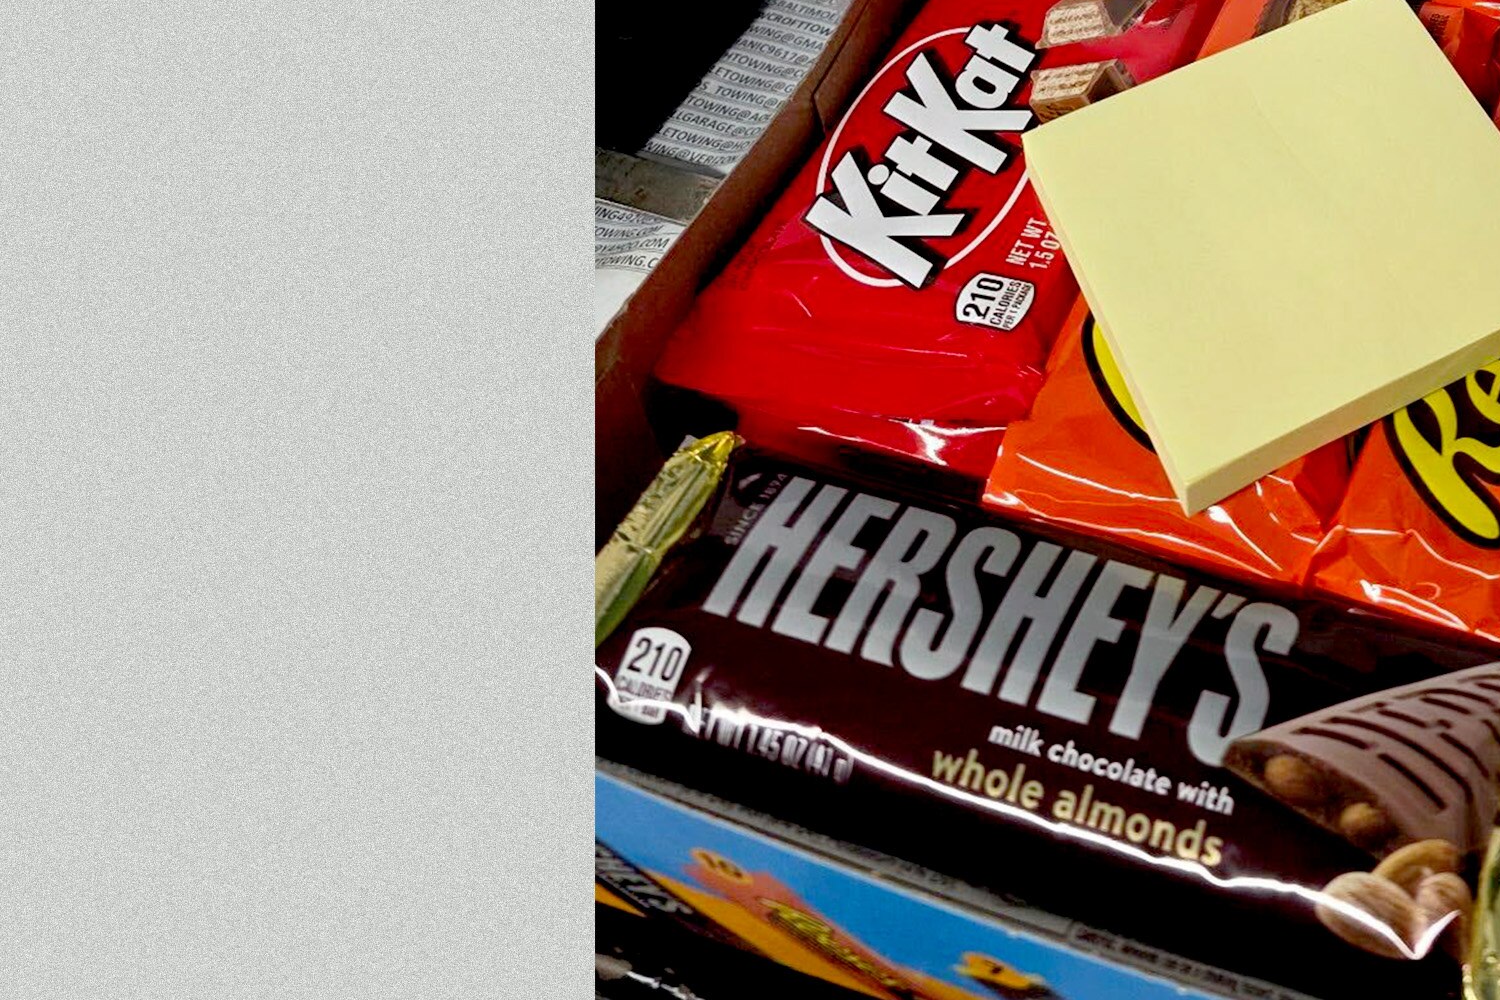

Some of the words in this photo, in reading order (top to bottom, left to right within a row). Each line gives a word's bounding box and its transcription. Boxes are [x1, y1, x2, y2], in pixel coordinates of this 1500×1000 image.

[709, 65, 794, 93] ETOWING@G
[1006, 239, 1034, 265] NET
[1021, 217, 1047, 239] WT
[1029, 250, 1055, 269] 1.5
[963, 277, 1004, 320] 210
[990, 281, 1022, 326] CALORIES
[1003, 314, 1015, 329] PER
[702, 475, 1299, 767] HERSHEY'S
[627, 637, 682, 681] 210
[987, 722, 1044, 757] milk
[1047, 740, 1172, 797] chocolate
[1176, 781, 1235, 816] with
[931, 748, 1045, 810] whole
[1052, 784, 1224, 868] almonds
